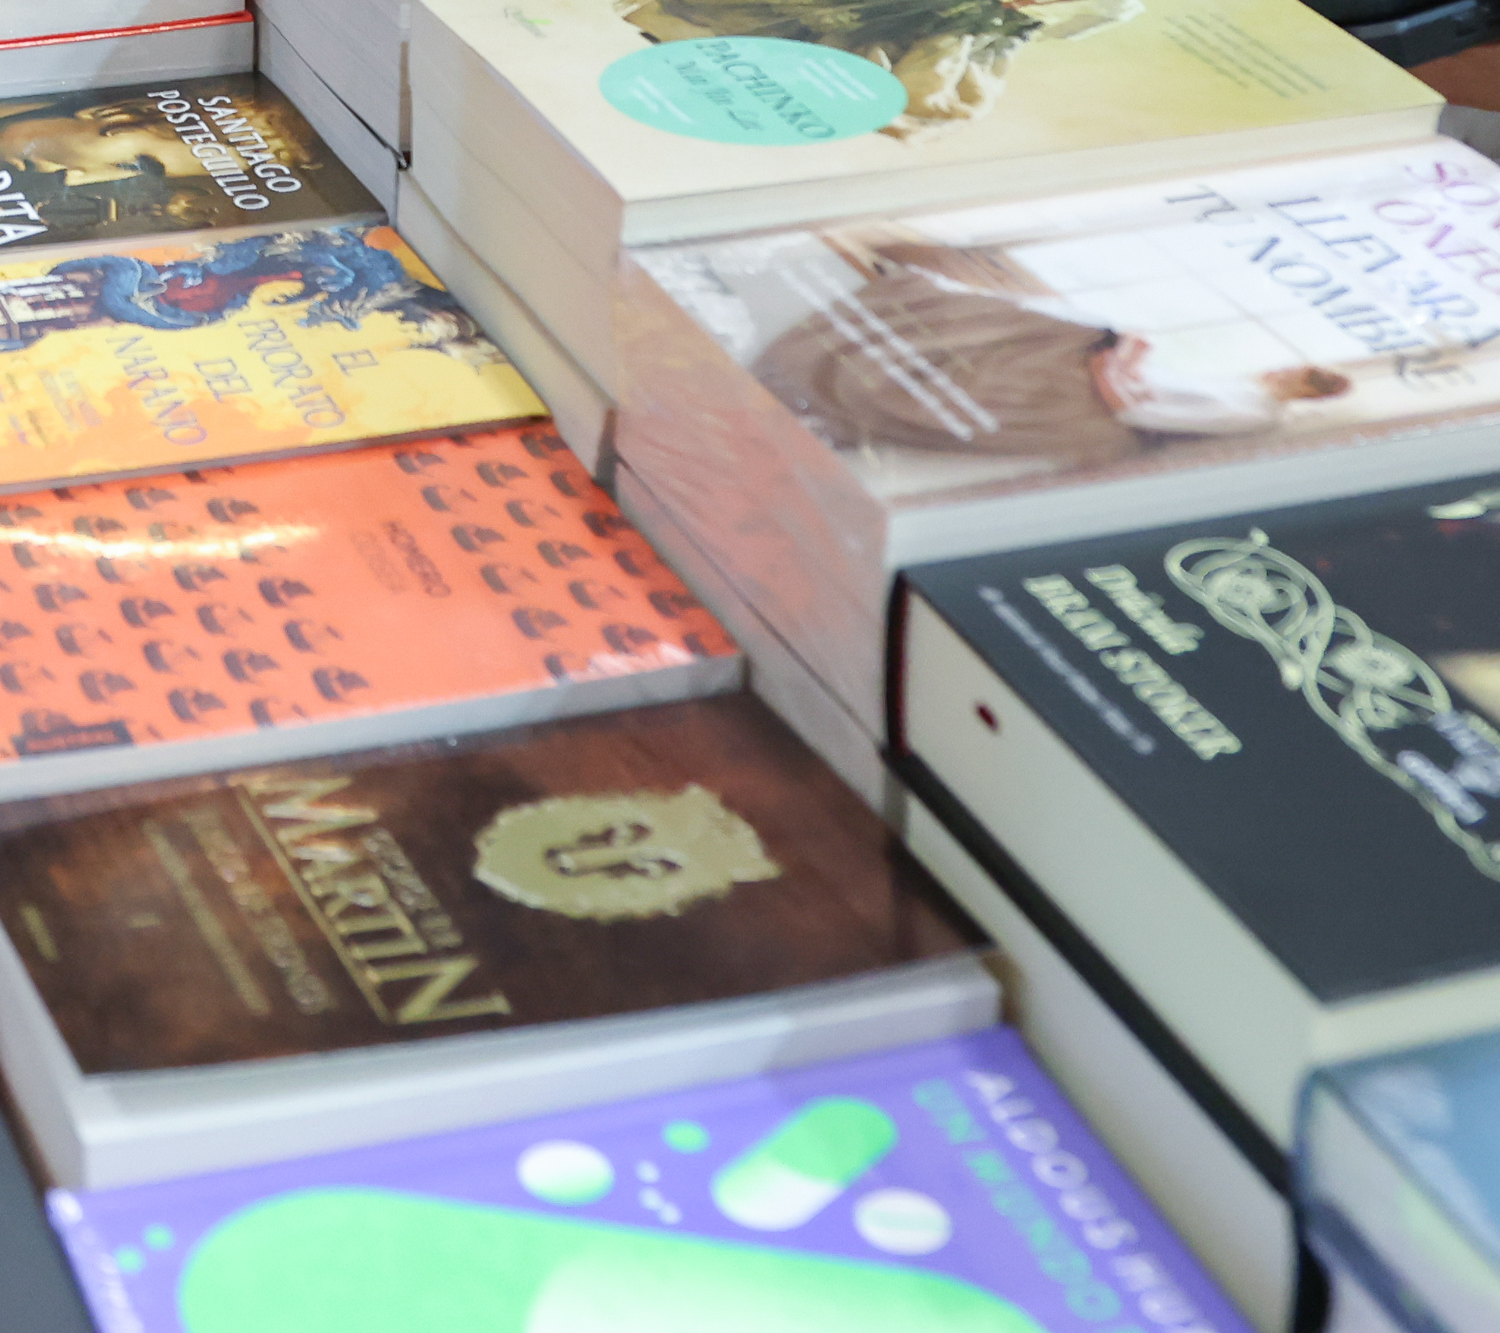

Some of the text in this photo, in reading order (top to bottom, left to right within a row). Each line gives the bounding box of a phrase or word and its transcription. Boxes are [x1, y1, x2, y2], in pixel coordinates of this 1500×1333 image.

[198, 95, 301, 193] SANTIAGO
[696, 41, 836, 139] PACHINKO
[148, 90, 270, 211] POSTEGUILLO
[194, 357, 252, 398] DEL
[240, 320, 348, 431] PRIORATO
[1023, 574, 1131, 651] BRAM
[1101, 647, 1243, 760] STOKER
[226, 776, 512, 1024] MARTIN
